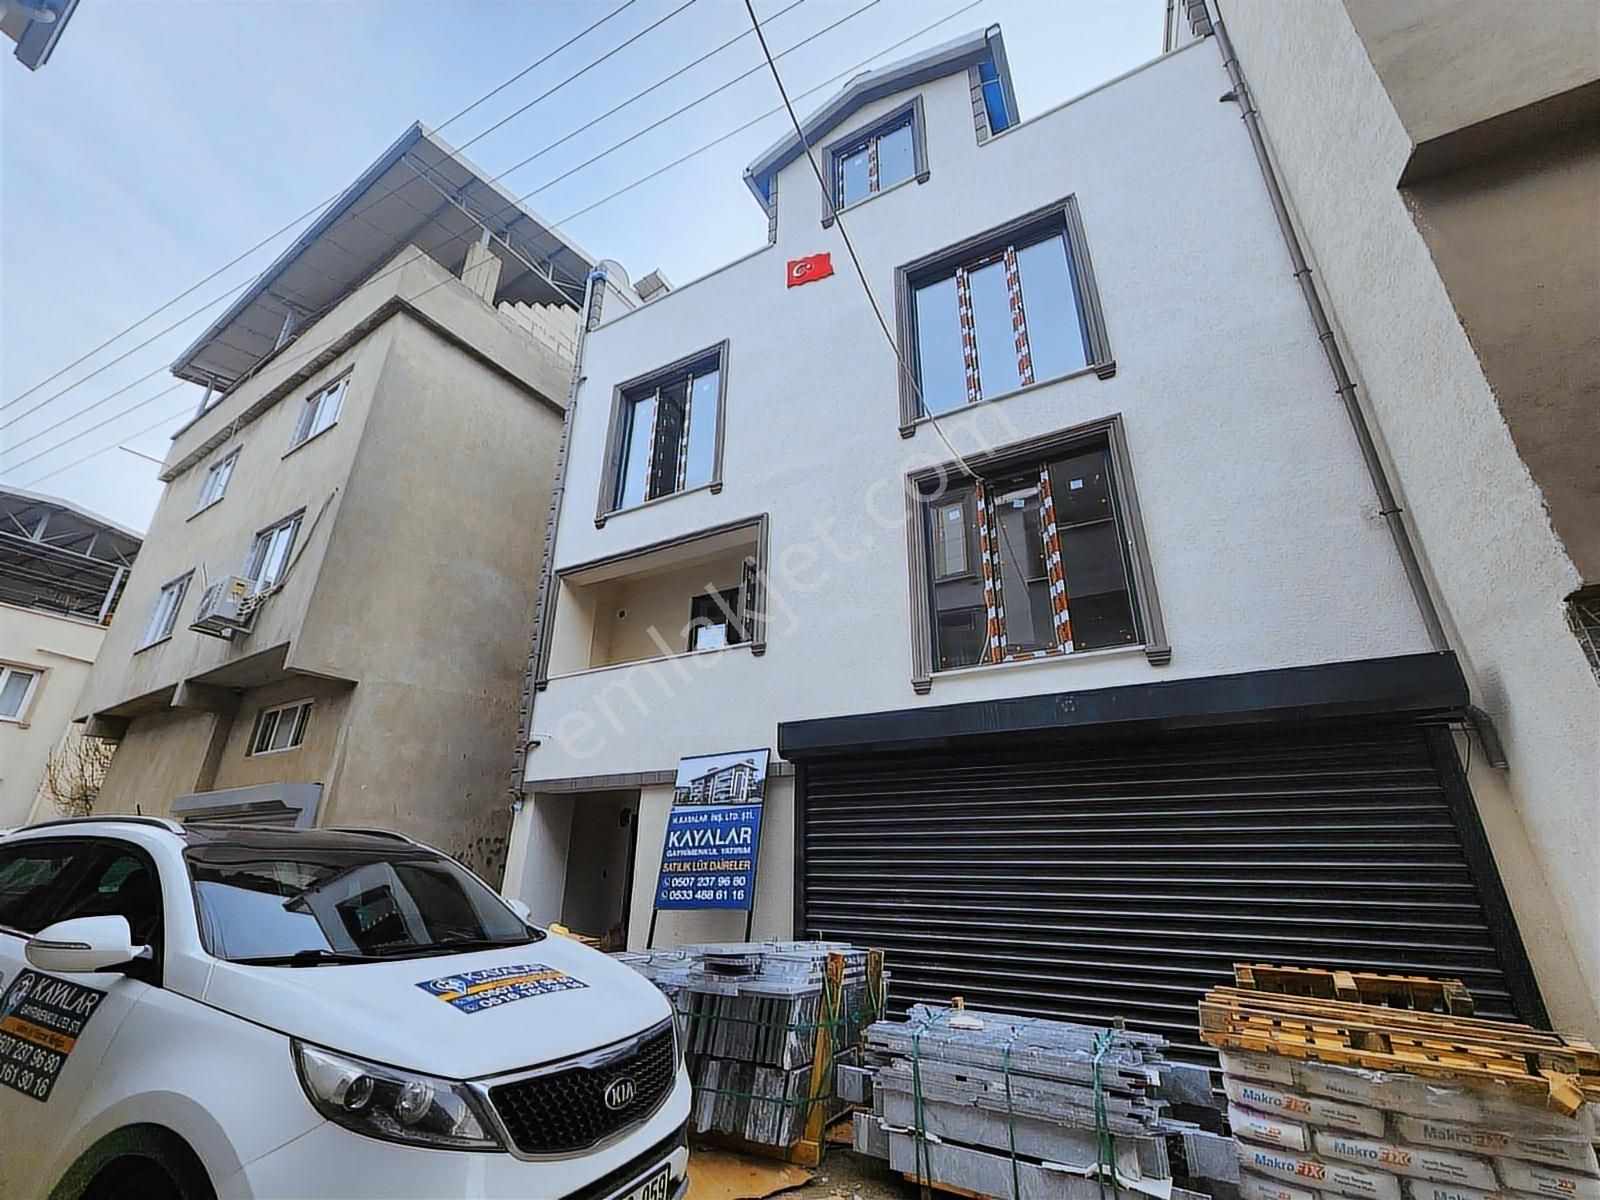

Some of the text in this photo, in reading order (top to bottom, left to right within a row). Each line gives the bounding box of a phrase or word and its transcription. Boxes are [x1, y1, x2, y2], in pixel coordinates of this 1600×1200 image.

[668, 827, 752, 848] KAYALAR
[697, 876, 716, 887] 237
[718, 876, 731, 887] 96
[716, 889, 728, 900] 61
[732, 889, 745, 900] 16
[30, 977, 99, 1017] KAYALAR
[612, 1082, 634, 1106] KIA
[1254, 1153, 1295, 1172] Makro
